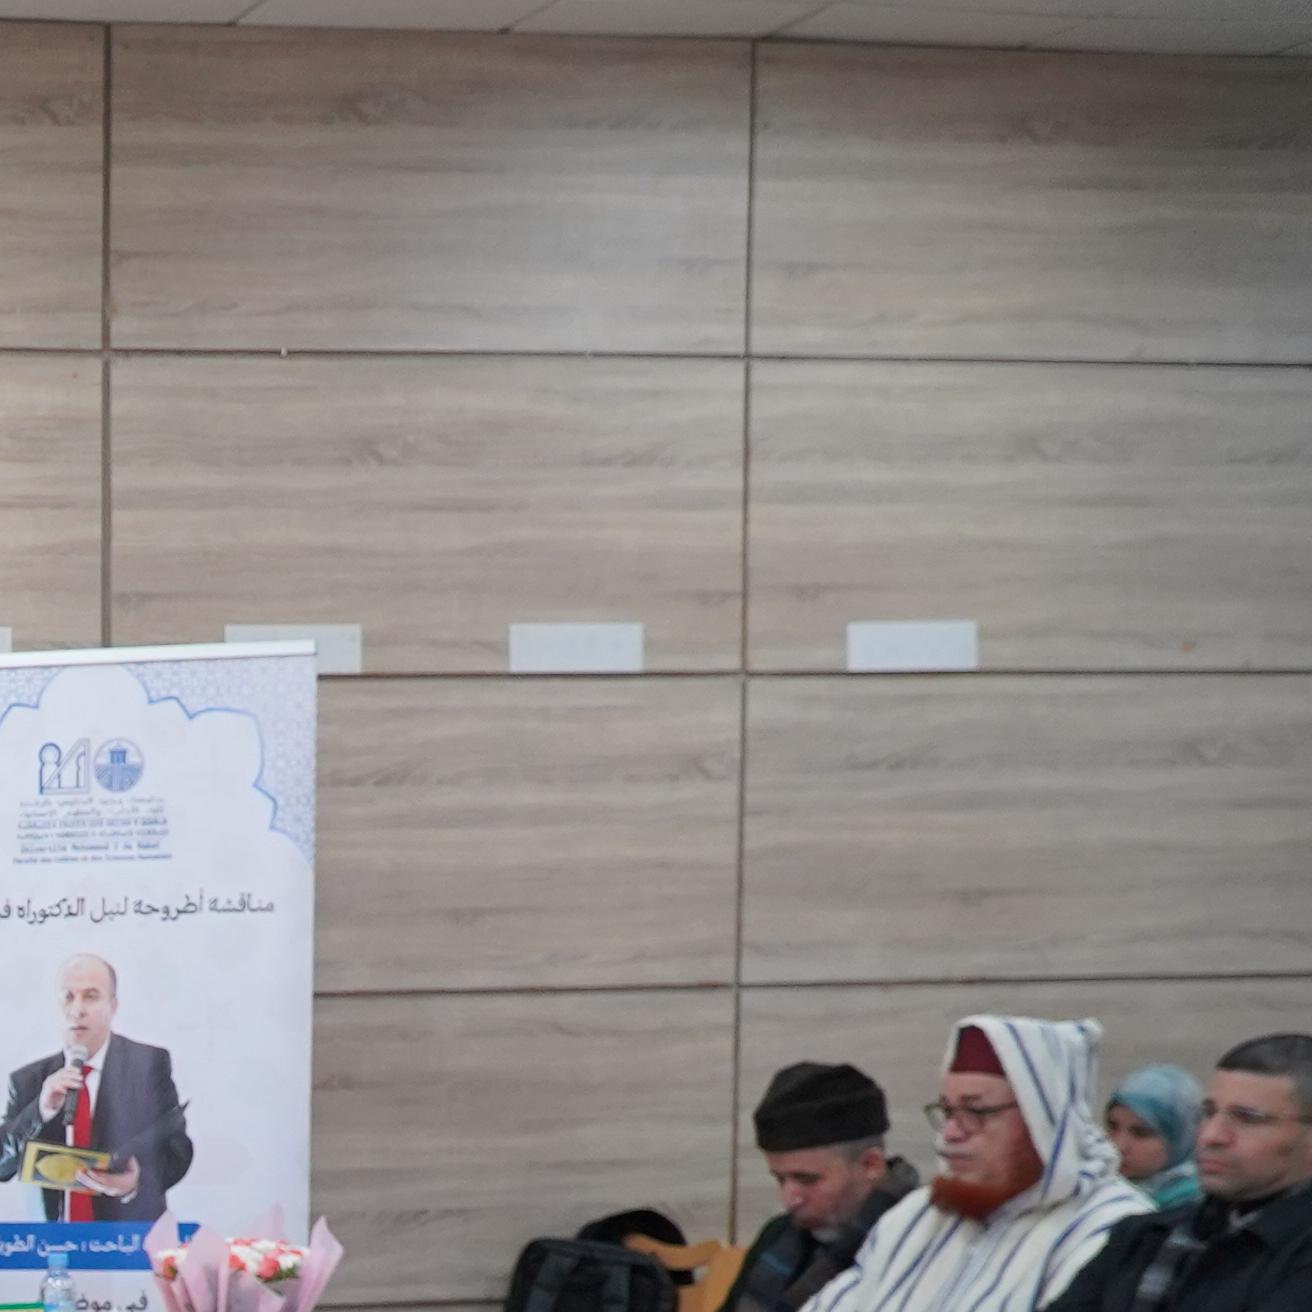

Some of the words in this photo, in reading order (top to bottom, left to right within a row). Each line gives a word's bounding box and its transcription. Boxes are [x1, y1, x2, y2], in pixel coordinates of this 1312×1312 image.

[89, 896, 128, 923] لنيل
[134, 888, 205, 921] أطروحة
[208, 893, 275, 914] مناقشة
[37, 1240, 78, 1257] حسن
